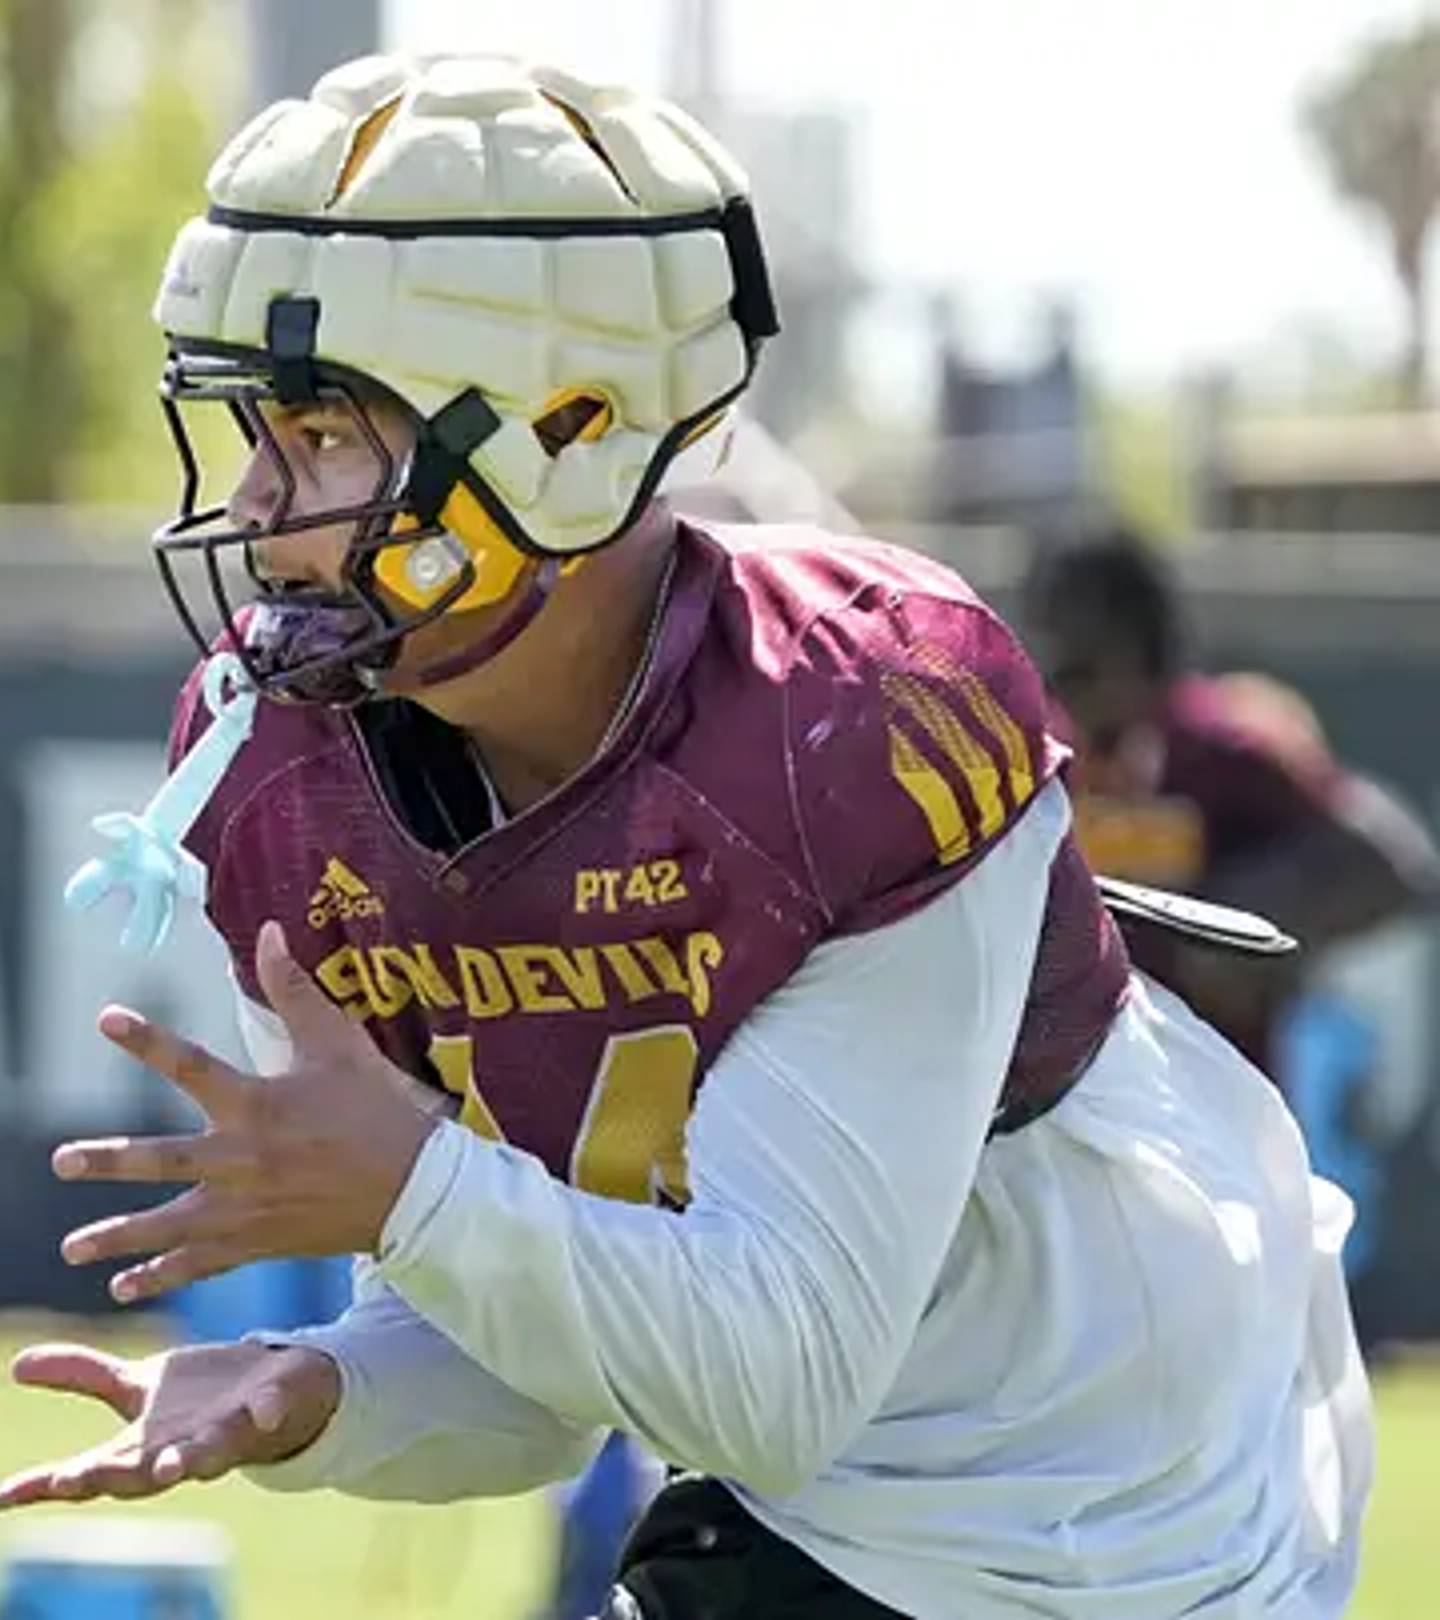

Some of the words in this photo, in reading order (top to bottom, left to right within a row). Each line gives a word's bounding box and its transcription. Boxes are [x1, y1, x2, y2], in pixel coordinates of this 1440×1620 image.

[575, 859, 689, 913] PT42
[315, 944, 460, 1020] SUN
[453, 931, 723, 1018] DEVILS
